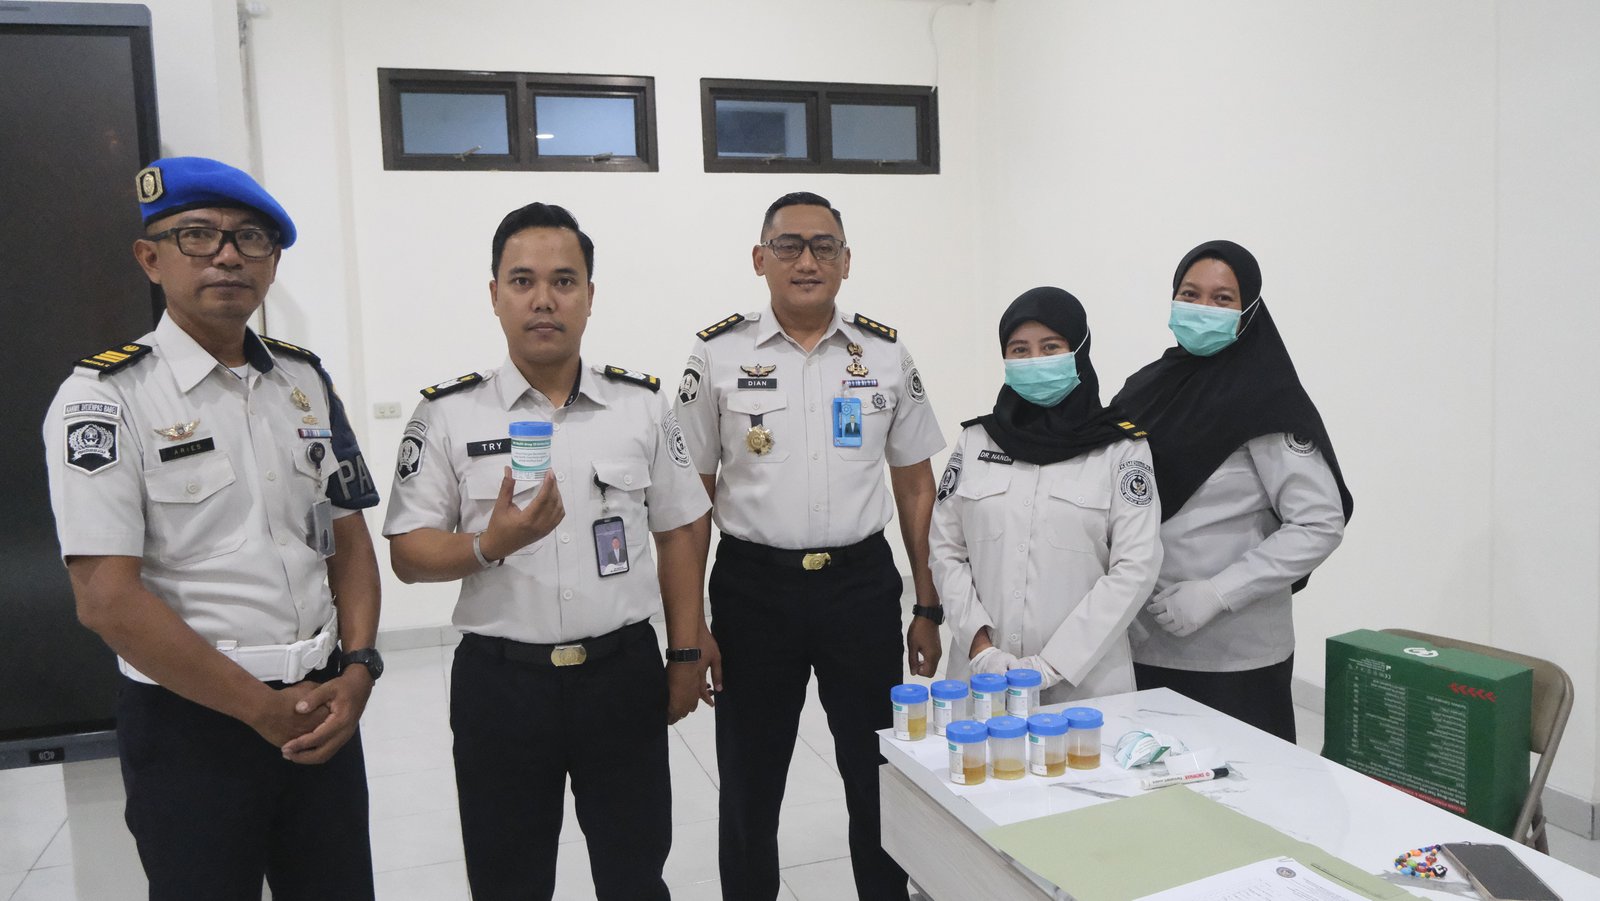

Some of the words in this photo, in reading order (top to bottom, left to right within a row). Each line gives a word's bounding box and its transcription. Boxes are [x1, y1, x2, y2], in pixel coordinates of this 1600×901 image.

[174, 443, 202, 456] ARIES
[481, 441, 503, 452] TRY
[337, 454, 373, 500] PA
